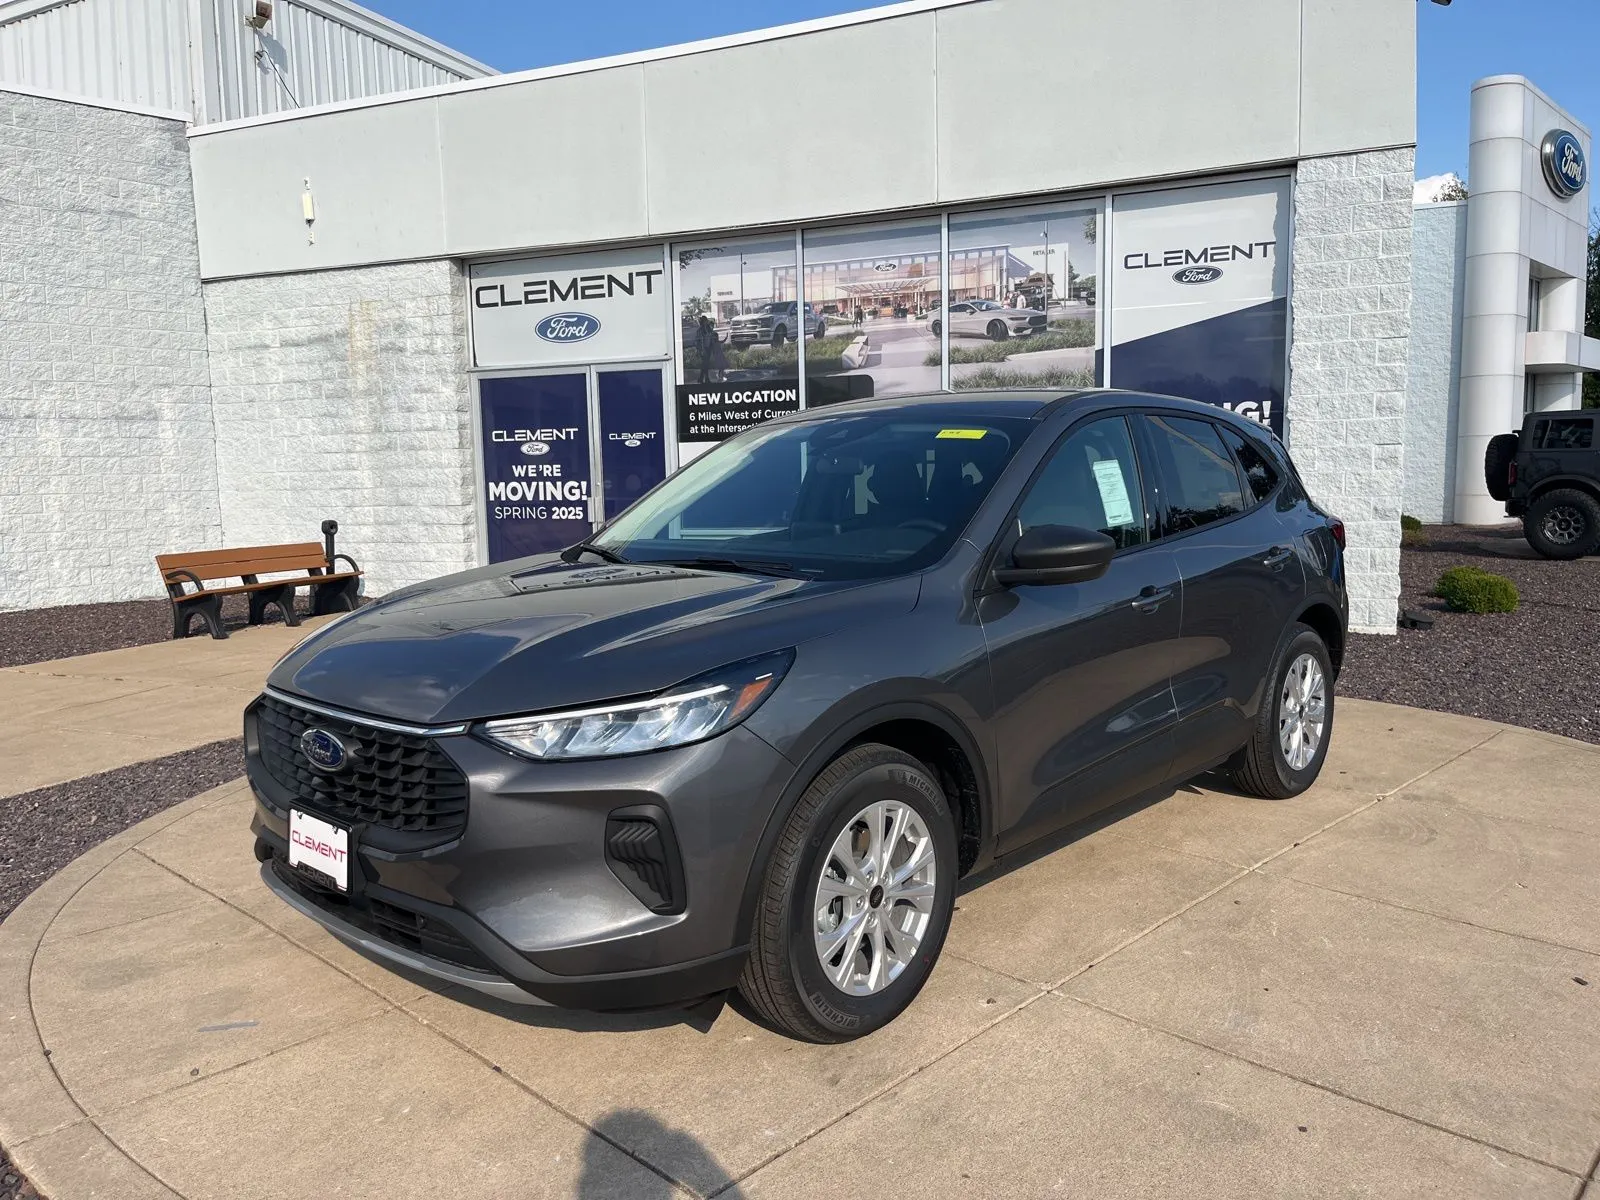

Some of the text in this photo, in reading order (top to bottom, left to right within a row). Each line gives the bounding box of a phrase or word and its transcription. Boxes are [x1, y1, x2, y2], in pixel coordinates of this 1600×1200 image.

[1561, 142, 1583, 182] Ford
[1124, 241, 1276, 270] CLEMENT
[475, 270, 662, 308] CLEMENT
[547, 316, 588, 338] Ford
[688, 389, 797, 406] NEW LOCATION
[689, 412, 696, 421] 6
[698, 411, 722, 421] Miles
[724, 410, 749, 420] West
[751, 409, 762, 419] of
[491, 427, 579, 442] CLEMENT
[608, 431, 657, 440] CLEMENT
[689, 425, 699, 434] at
[700, 424, 715, 433] the
[488, 480, 588, 501] MOVING!
[494, 506, 584, 520] SPRING 2025
[292, 830, 347, 863] CLEMENT
